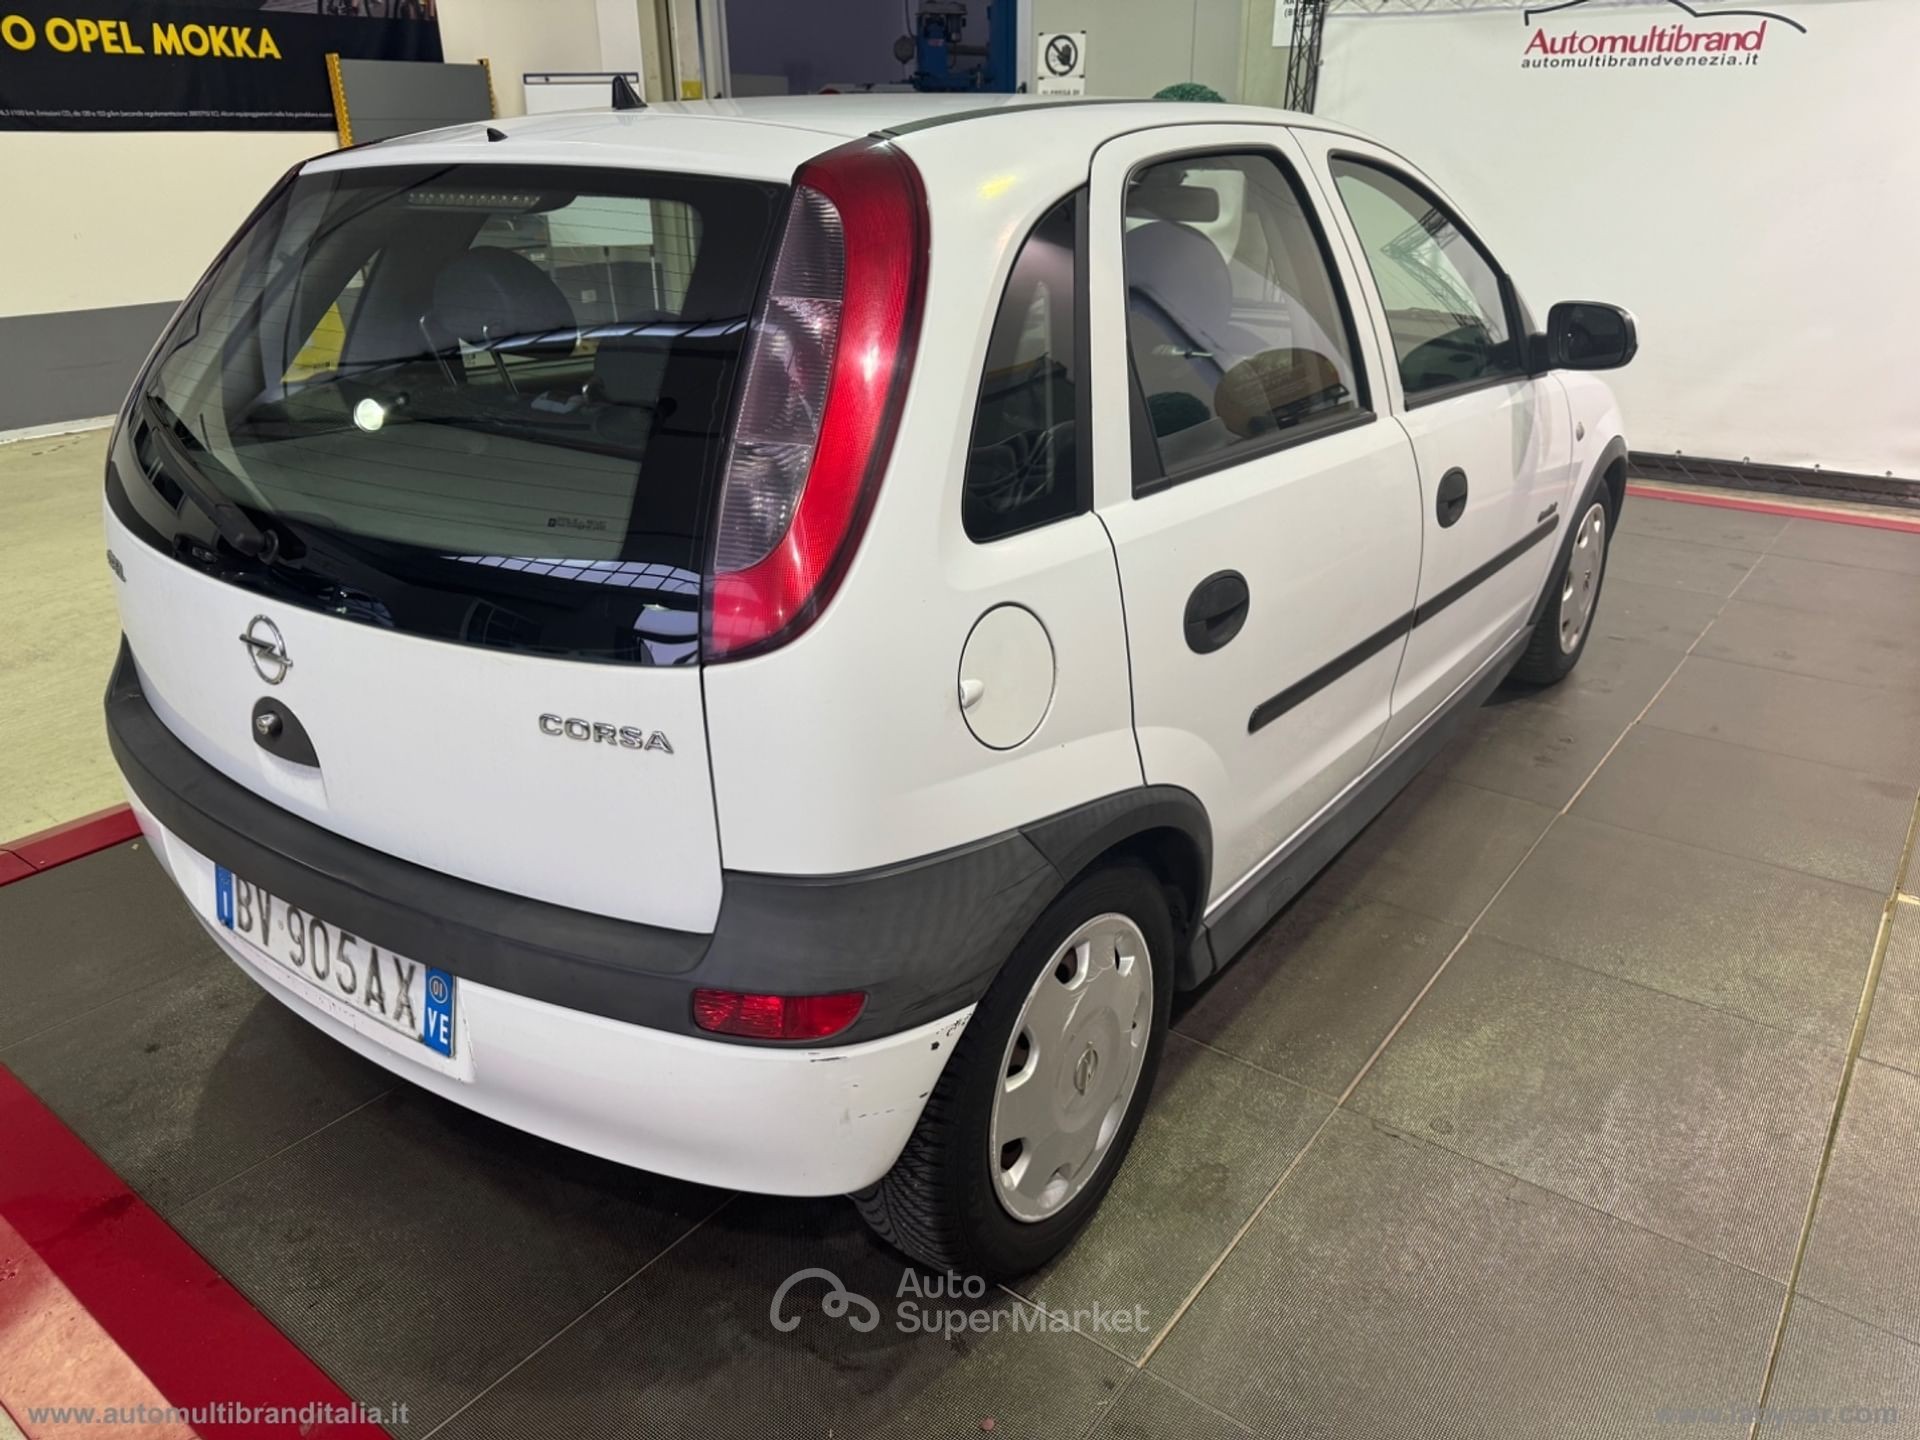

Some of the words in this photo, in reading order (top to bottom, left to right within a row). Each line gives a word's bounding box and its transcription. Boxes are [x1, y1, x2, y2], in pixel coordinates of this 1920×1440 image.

[1, 15, 36, 51] O
[45, 18, 145, 55] OPEL
[153, 23, 282, 59] MOKKA
[1524, 20, 1767, 55] Automultibrand
[1521, 53, 1759, 69] automultibrandvenezia.it
[538, 713, 674, 754] CORSA
[236, 876, 272, 947] BV
[427, 1007, 449, 1045] VE
